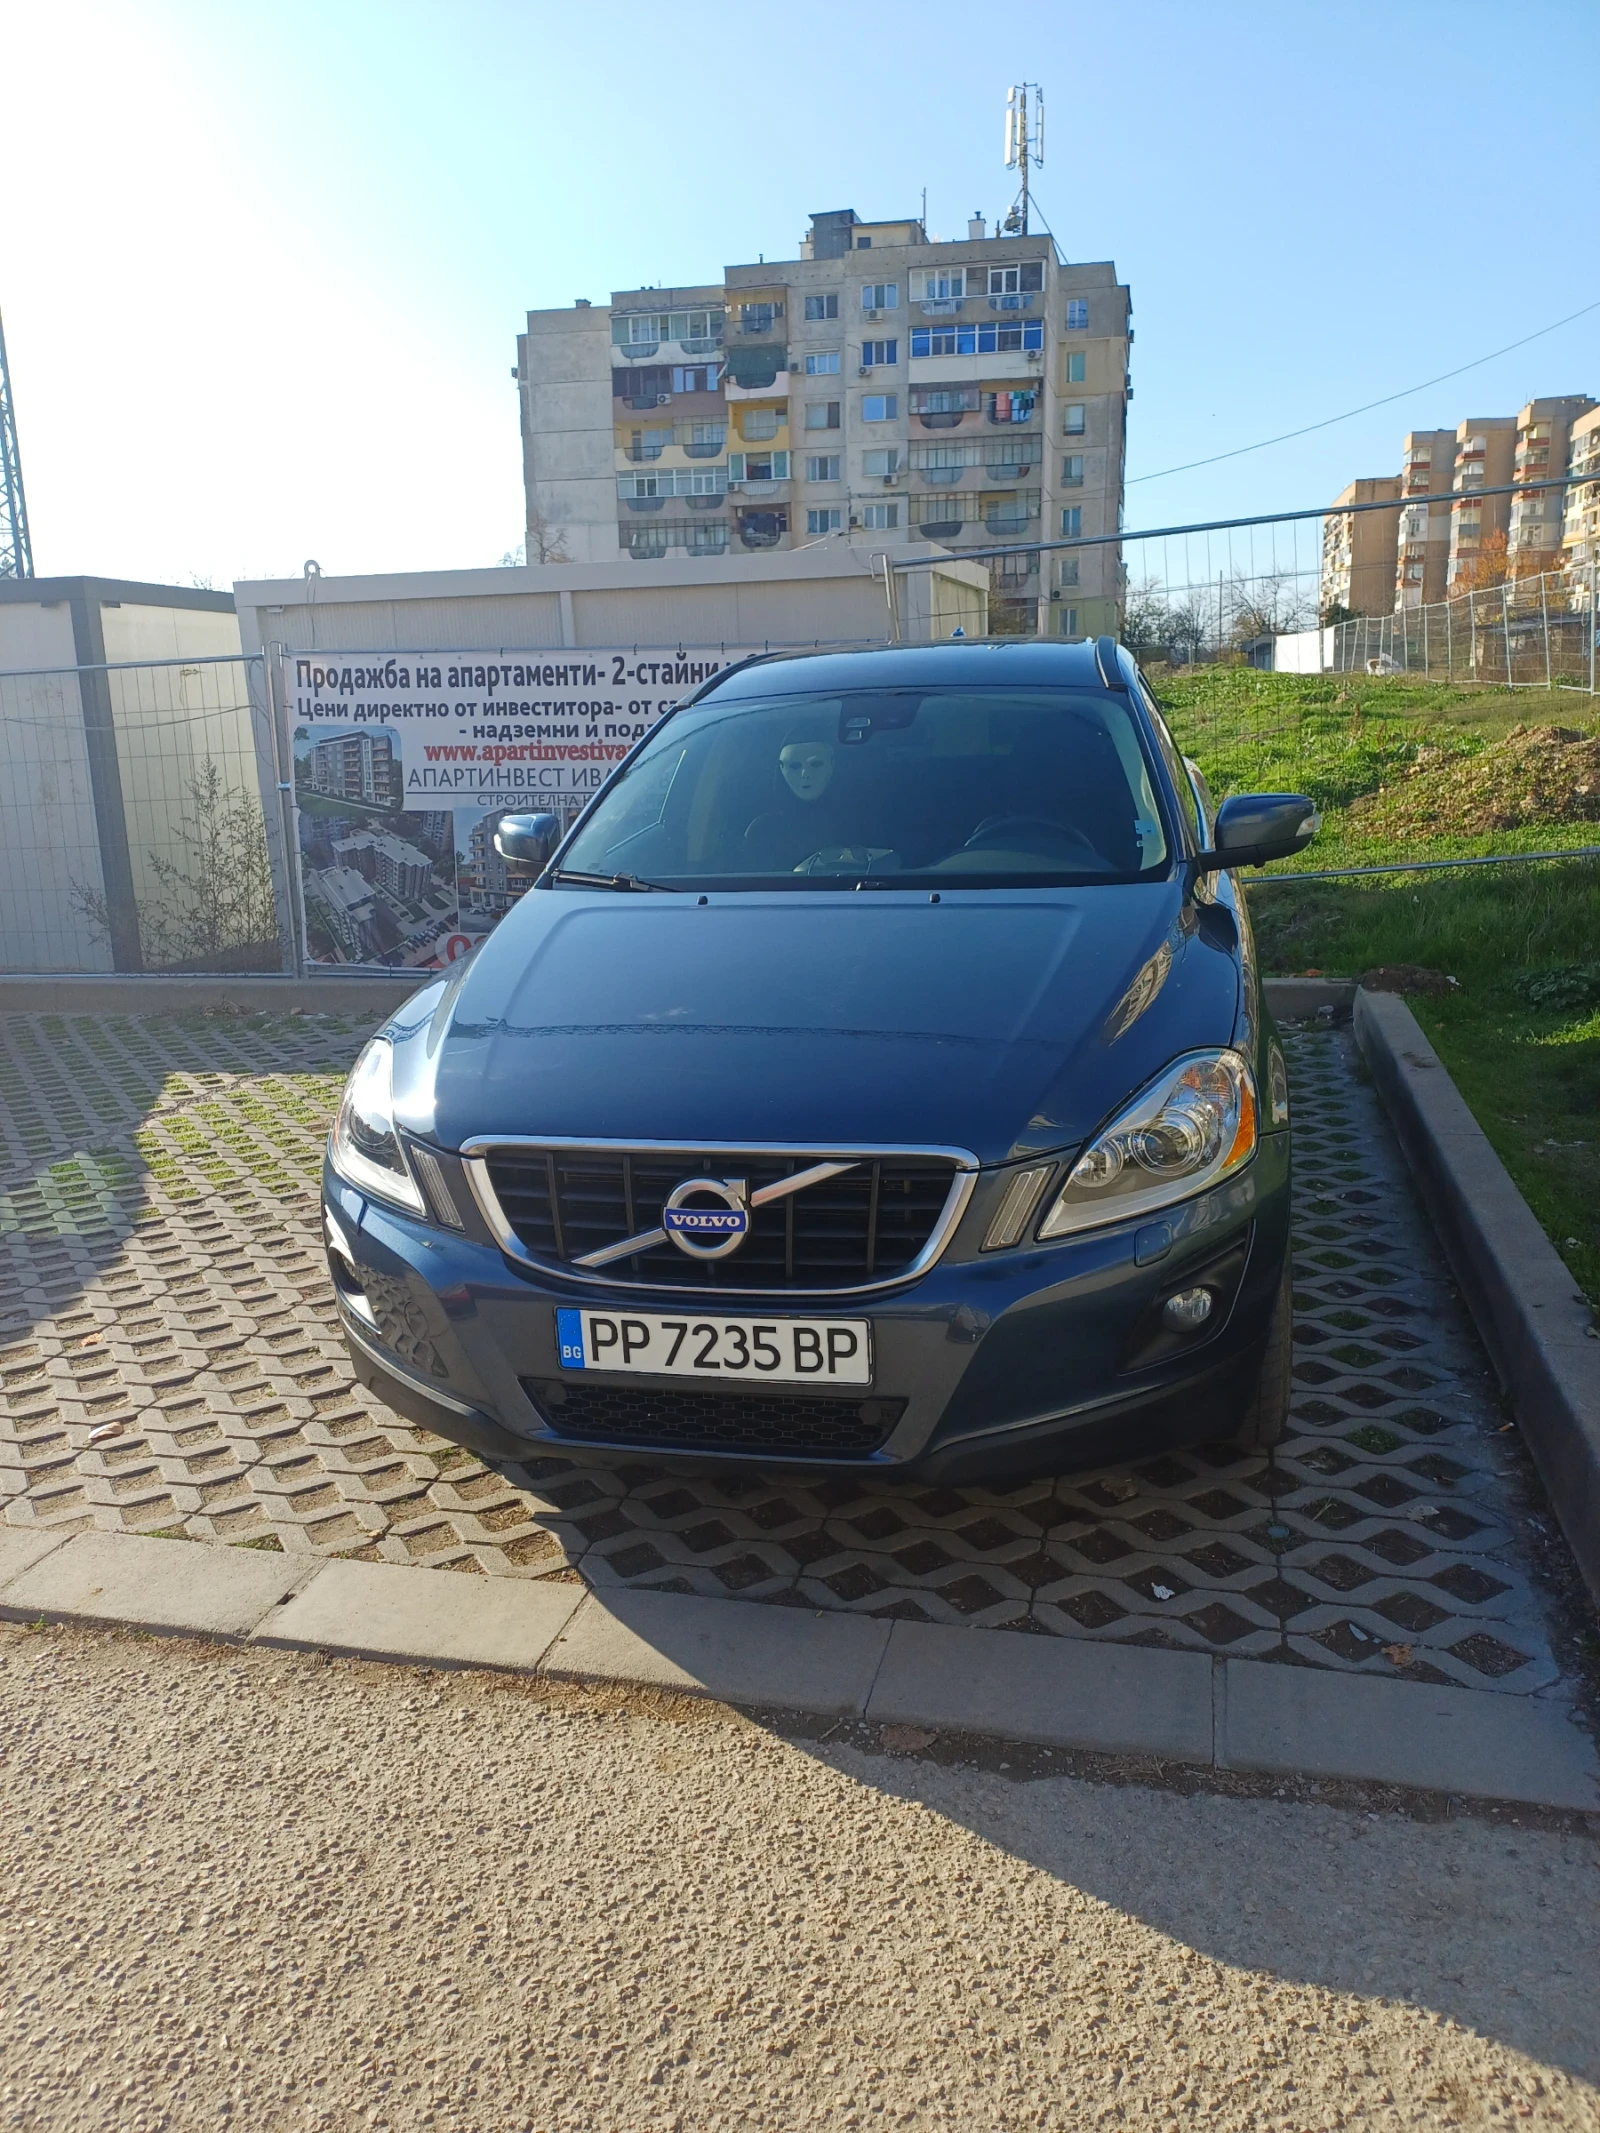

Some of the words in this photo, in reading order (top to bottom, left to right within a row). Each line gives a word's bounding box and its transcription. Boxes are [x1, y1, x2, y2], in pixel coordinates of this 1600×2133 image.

[296, 659, 410, 698] Продажба
[416, 666, 442, 688] на
[298, 698, 348, 721] Цени
[353, 702, 449, 723] директно
[454, 702, 477, 717] от
[628, 700, 652, 715] от
[473, 724, 579, 742] надземни
[585, 725, 598, 738] и
[604, 724, 654, 741] под
[424, 739, 634, 767] www.apartinvestiva
[408, 767, 565, 787] АПАРТИНВЕСТ
[477, 794, 579, 806] СТРОИТЕЛНА
[669, 1214, 740, 1227] VOLVO
[562, 1345, 582, 1359] BG
[589, 1317, 650, 1364] PP
[661, 1321, 781, 1372] 7235
[793, 1327, 858, 1374] BP
